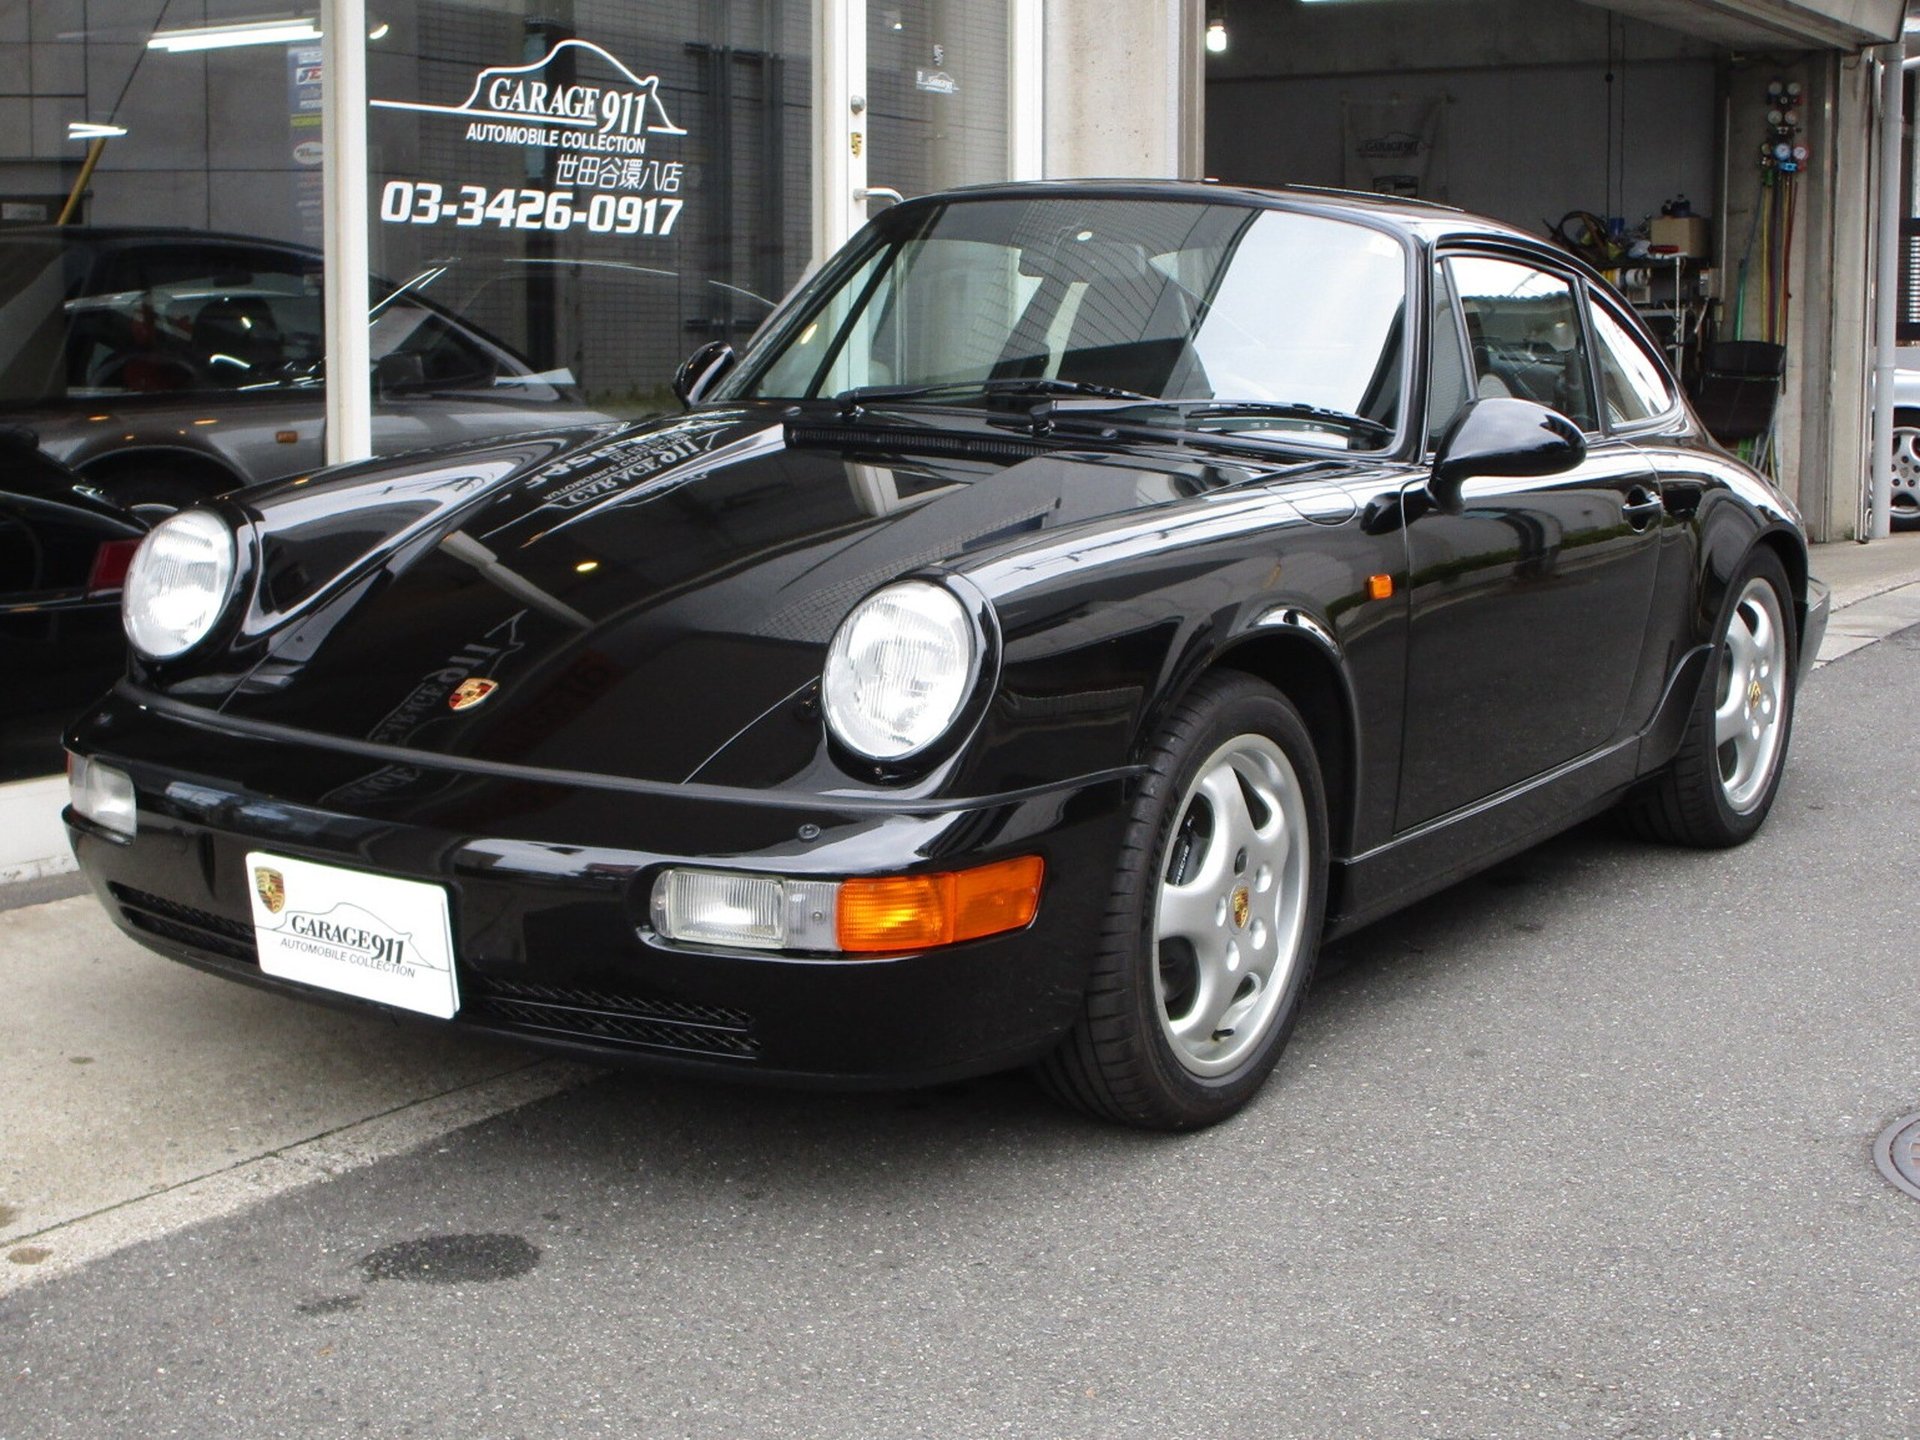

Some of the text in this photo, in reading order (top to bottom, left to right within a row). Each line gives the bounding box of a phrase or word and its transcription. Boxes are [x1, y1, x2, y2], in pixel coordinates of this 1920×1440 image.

[489, 78, 647, 135] GARAGE 911
[466, 123, 646, 154] AUTOMOBILE COLLECTION
[556, 154, 684, 192] 世田谷環八店
[380, 181, 684, 235] 03-3426-0917
[280, 938, 416, 978] AUTOMOBILE COLLECTION
[291, 915, 405, 965] GARAGE 911
